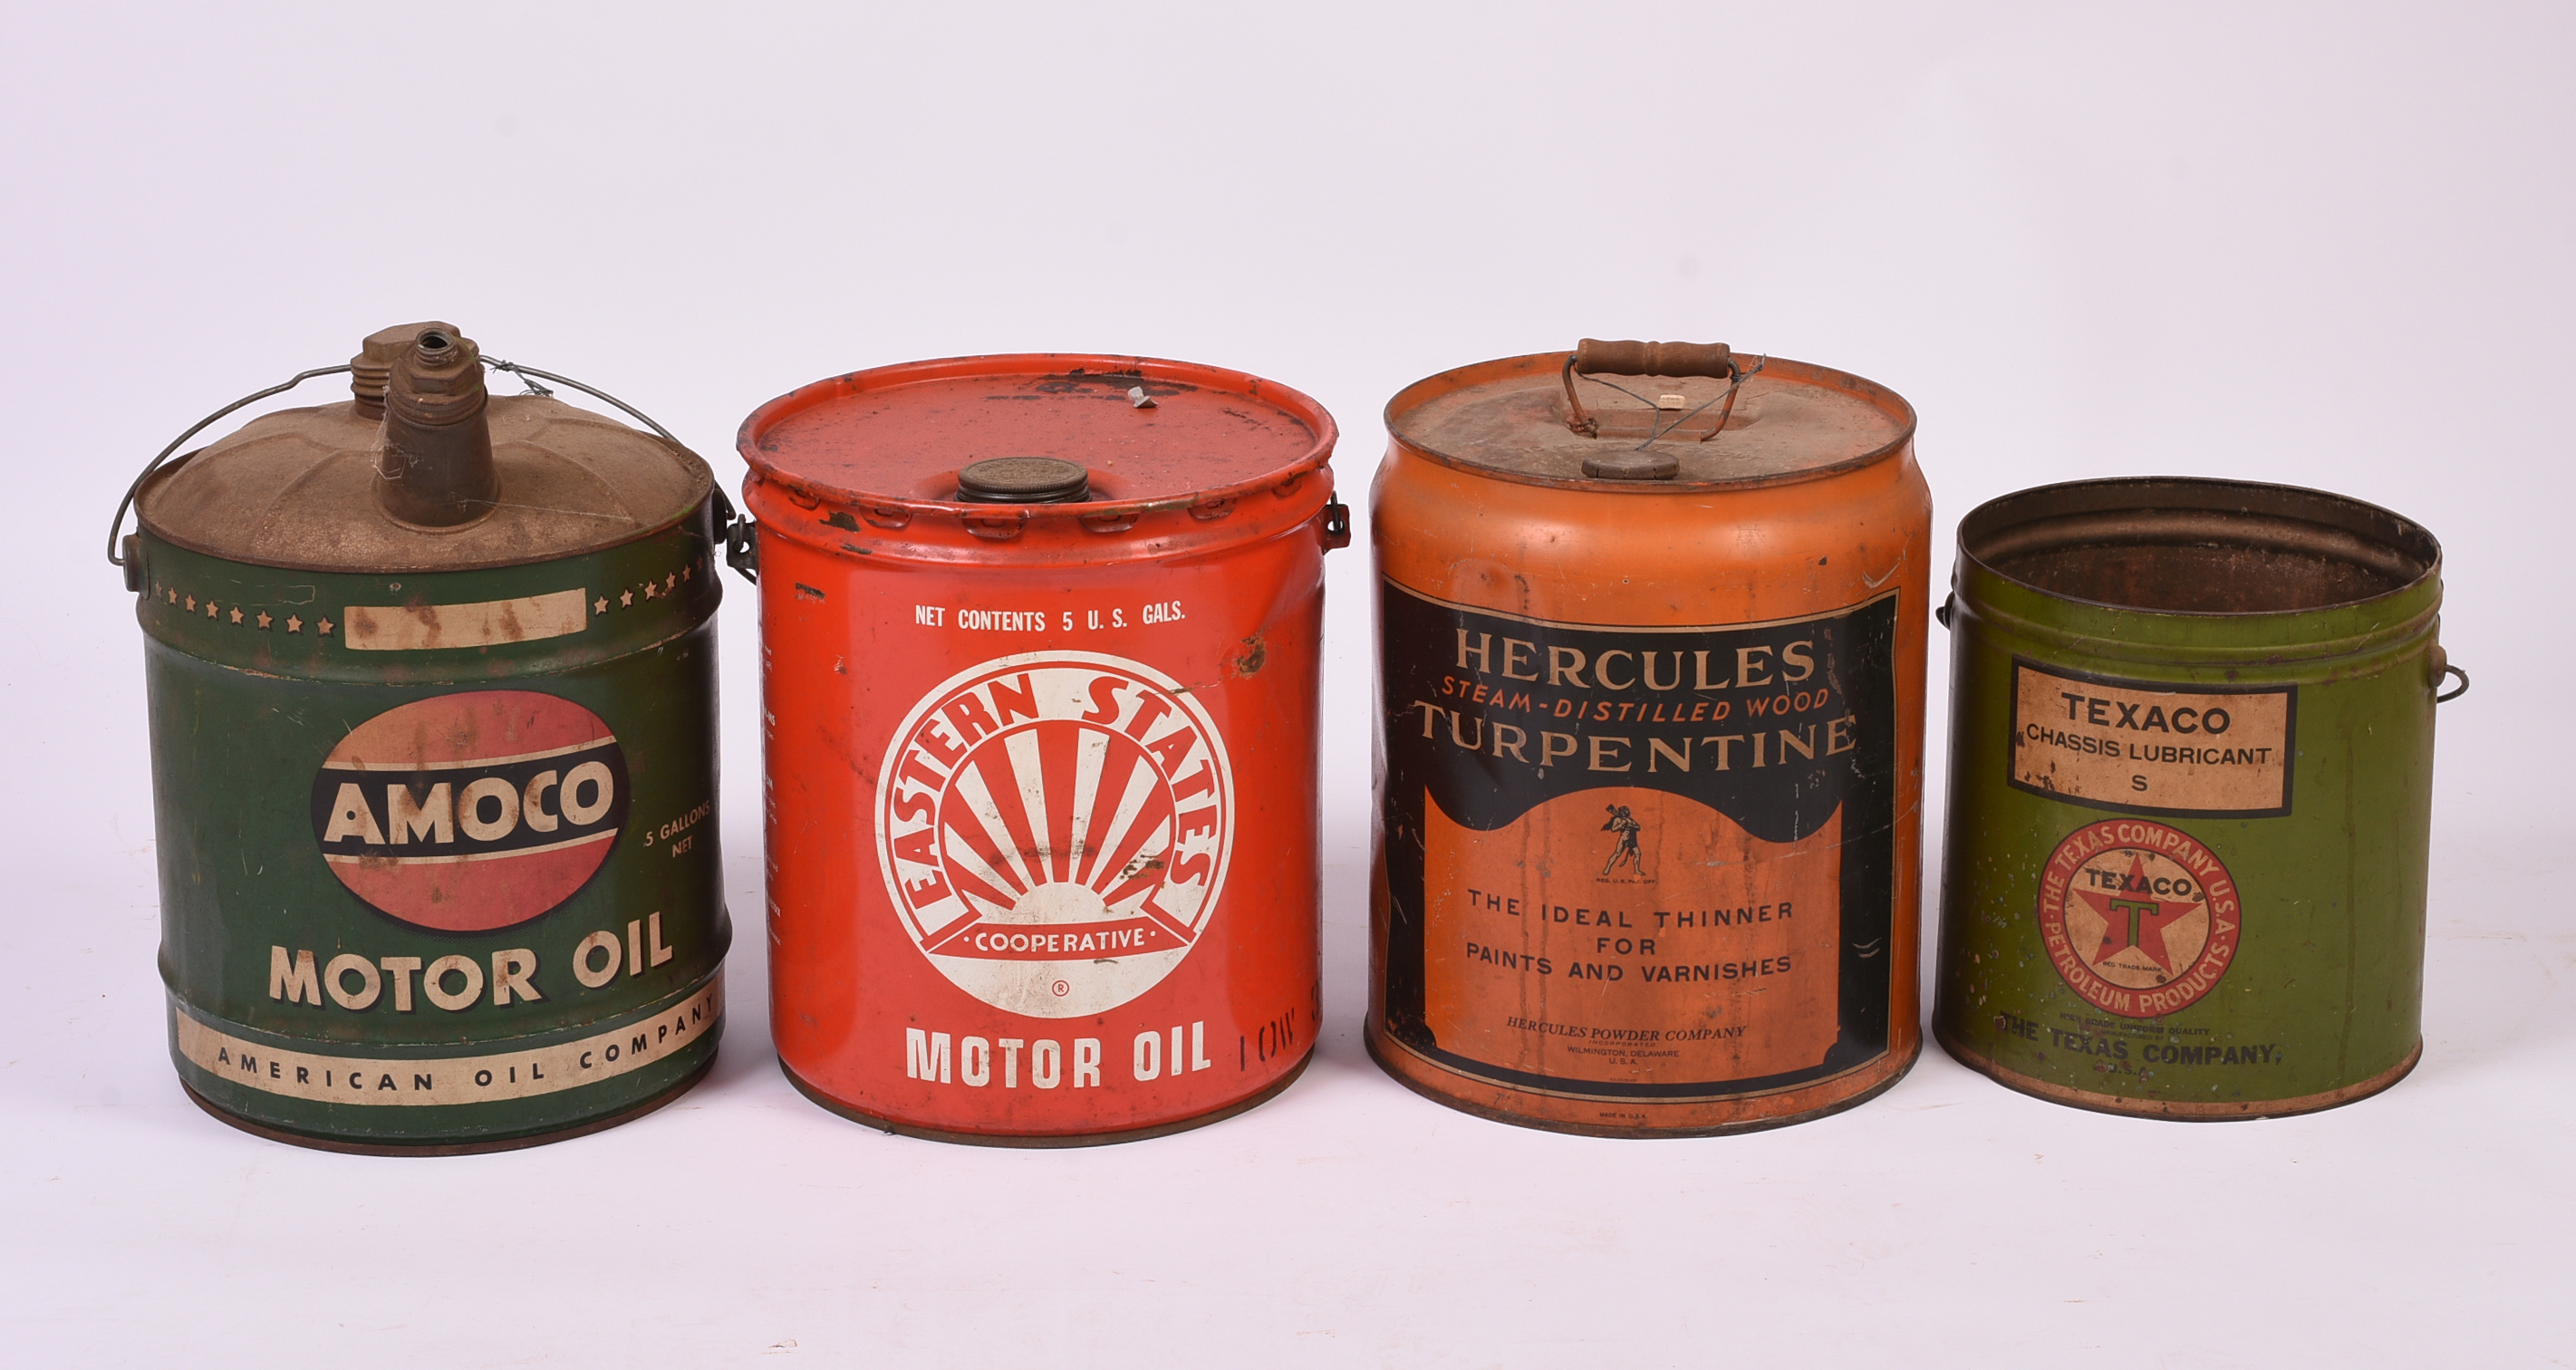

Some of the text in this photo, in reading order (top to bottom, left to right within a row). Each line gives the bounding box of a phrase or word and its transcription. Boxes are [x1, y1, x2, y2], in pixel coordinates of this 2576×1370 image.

[915, 604, 945, 627] NET
[958, 610, 1046, 632] CONTENTS
[1062, 611, 1074, 632] 5
[1143, 601, 1186, 625] GALS.
[1455, 627, 1815, 692] HERCULES
[1442, 675, 1829, 723] STEAM-DISTILLED WOOD
[2061, 691, 2231, 735] TEXACO
[1413, 699, 1858, 774] TURPENTINE
[2026, 722, 2272, 766] CHASSIS LUBRICANT
[323, 759, 615, 845] AMOCO
[893, 672, 1216, 909] EASTERN STATES
[2131, 774, 2148, 792] S
[645, 799, 710, 847] 5 GALLONS
[671, 835, 693, 859] NET
[2043, 871, 2065, 914] THE
[2054, 825, 2116, 872] TEXAS
[2117, 823, 2220, 877] COMPANY
[2084, 867, 2193, 896] TEXACO
[1467, 889, 1794, 929] THE IDEAL THINNER
[2108, 897, 2160, 948] T
[268, 911, 673, 1013] MOTOR OIL
[974, 928, 1146, 953] COOPERATIVE
[1466, 941, 1792, 984] PAINTS AND VARNISHES
[1597, 936, 1657, 956] FOR
[2044, 921, 2231, 1014] PETROLEUM PRODUCTS
[217, 992, 716, 1091] AMERICAN OIL COMPANY
[1506, 1016, 1748, 1042] HERCULES POWDER COMPANY
[1588, 1039, 1656, 1047] INCORPORATED
[1999, 1009, 2283, 1066] THE TEXAS COMPANY,
[2085, 1017, 2117, 1029] GRADE
[2119, 1022, 2165, 1035] UNIFORM
[2168, 1027, 2211, 1036] QUALITY
[2100, 1029, 2153, 1041] MANUFACTURED
[905, 1020, 1211, 1089] MOTOR OIL
[1567, 1046, 1680, 1058] WILMINGTON, DELAWARE
